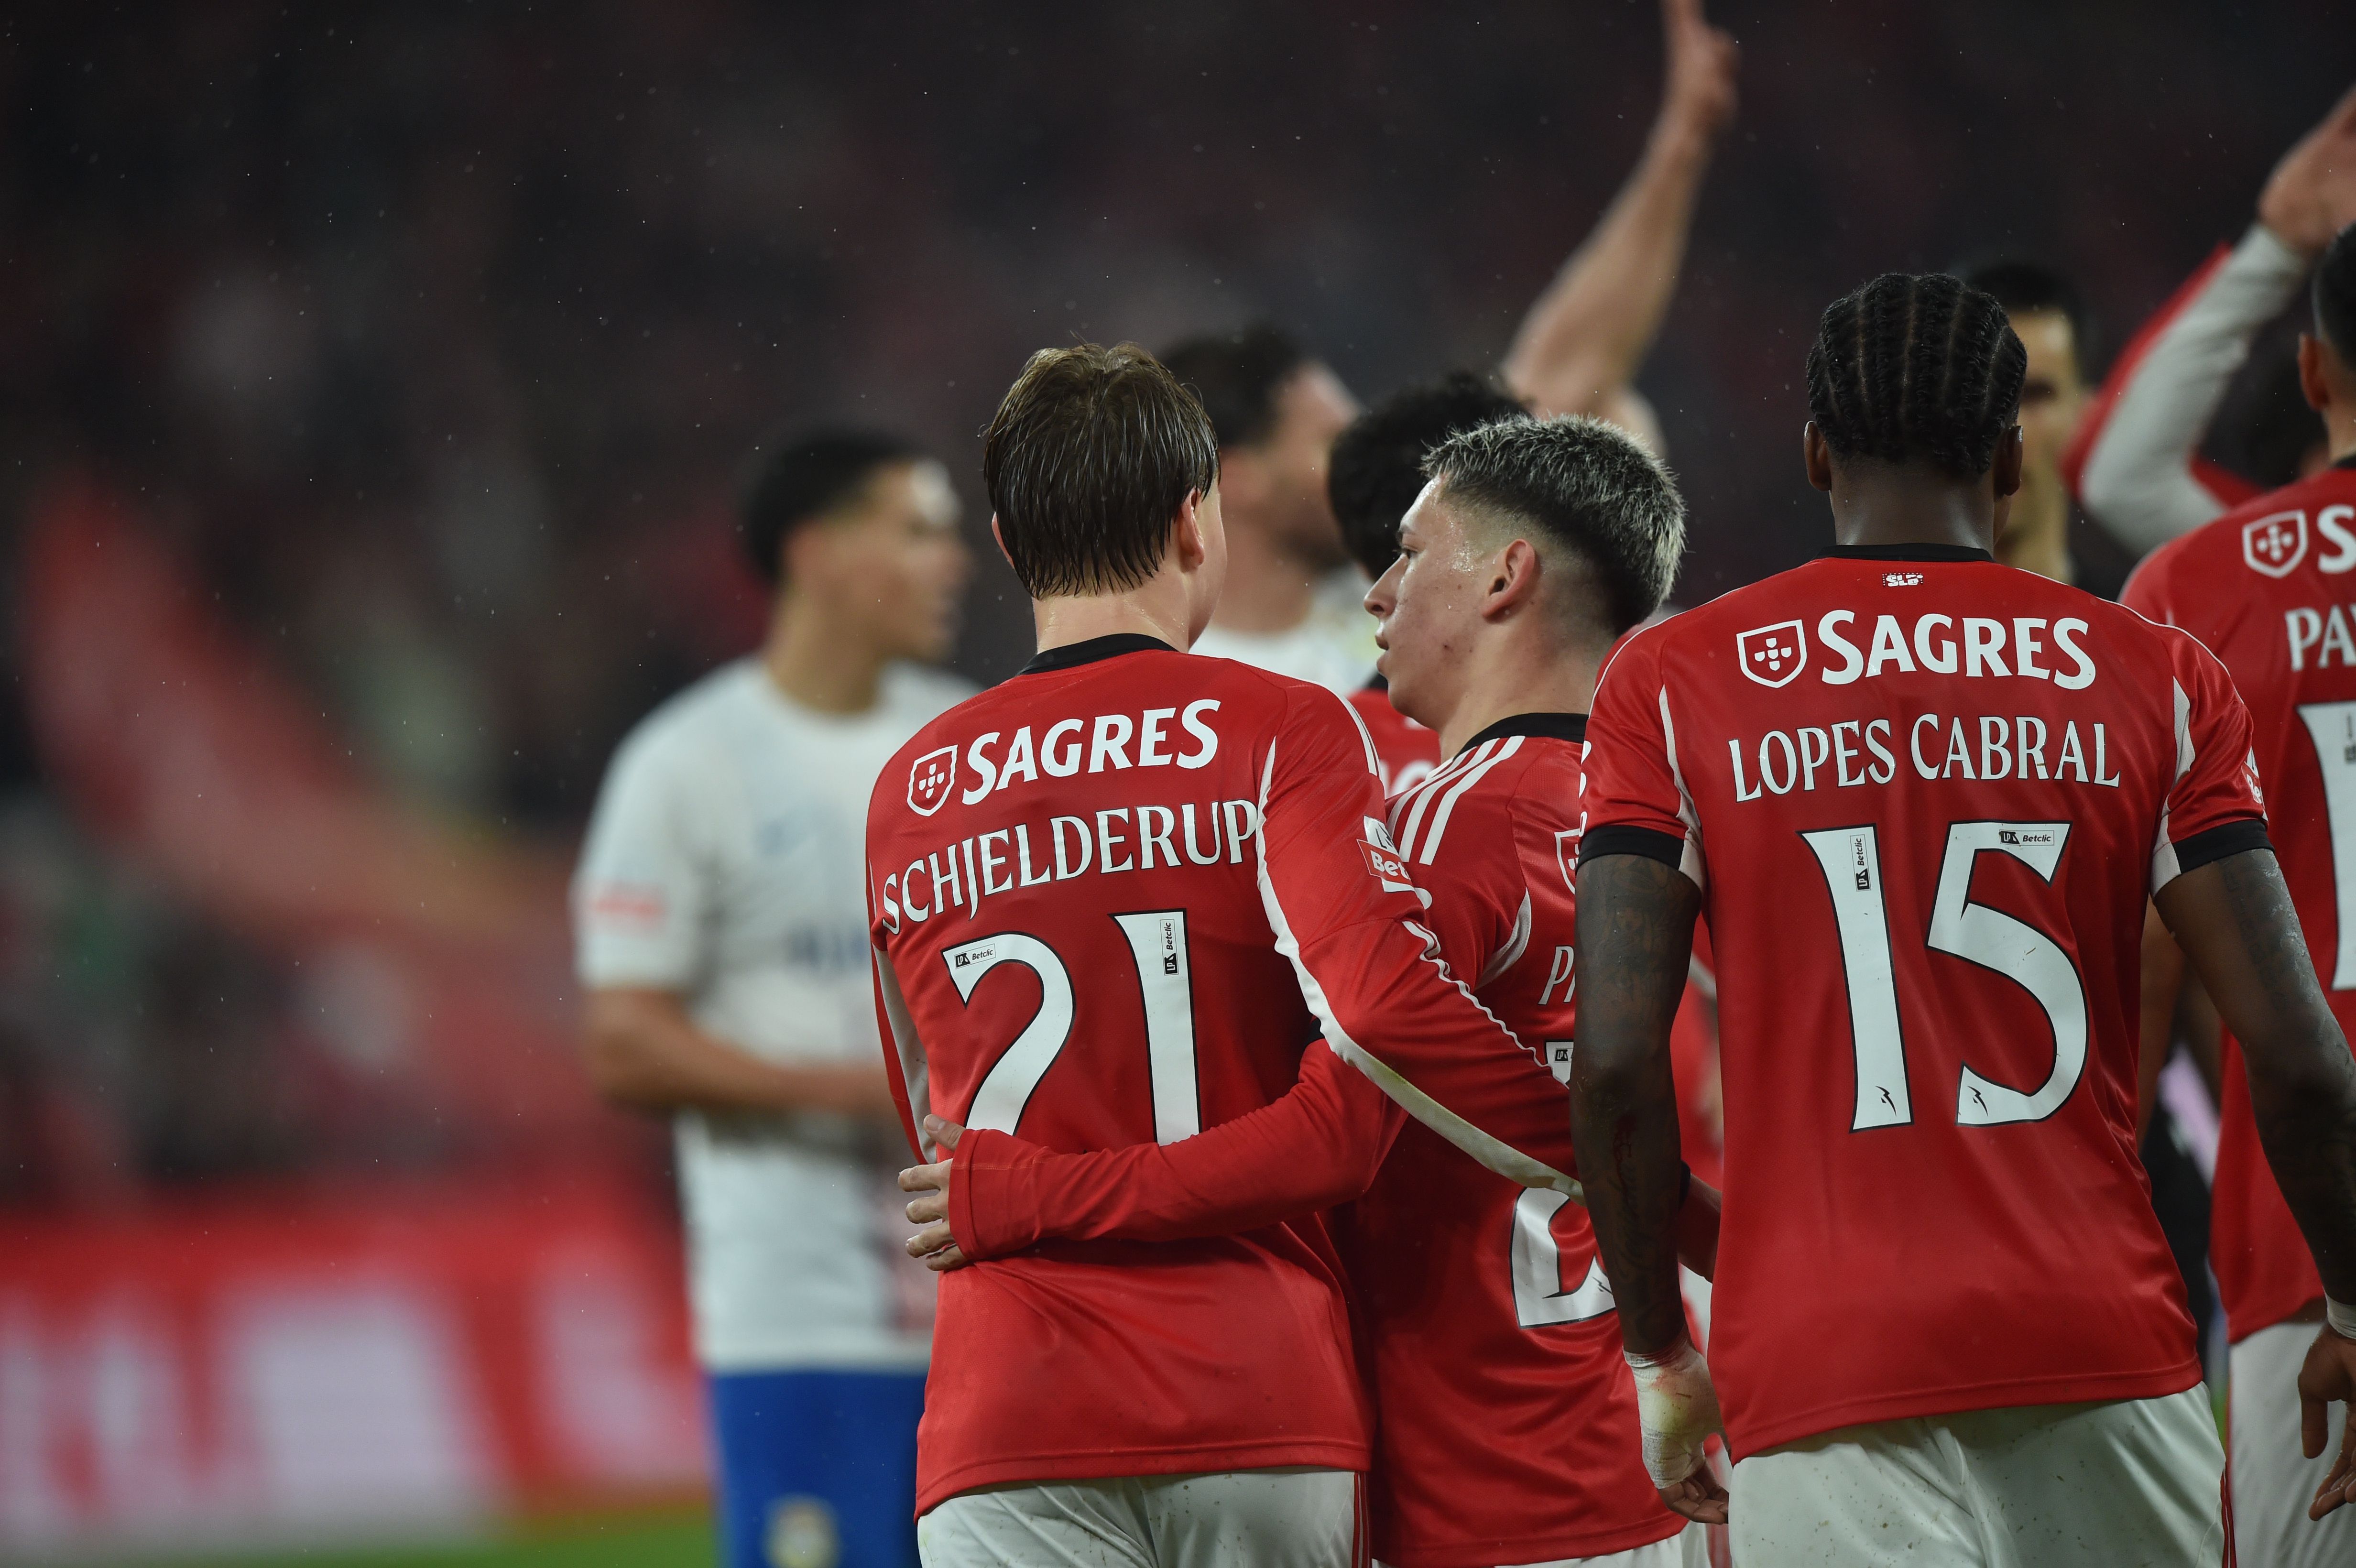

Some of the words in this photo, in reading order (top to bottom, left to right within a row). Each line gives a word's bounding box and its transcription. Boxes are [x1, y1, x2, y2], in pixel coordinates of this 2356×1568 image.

[1818, 610, 2096, 690] SAGRES
[2285, 604, 2356, 671] PA
[962, 699, 1221, 805] SAGRES
[1728, 719, 1896, 803] LOPES
[1911, 713, 2122, 788] CABRAL
[882, 799, 1258, 935] SCHJELDERUP
[1854, 838, 1865, 866] Betclic
[2022, 834, 2051, 842] Betclic
[972, 949, 993, 960] Betclic
[1164, 922, 1173, 950] Betclic
[1796, 819, 2089, 1133] 15
[940, 908, 1202, 1146] 21
